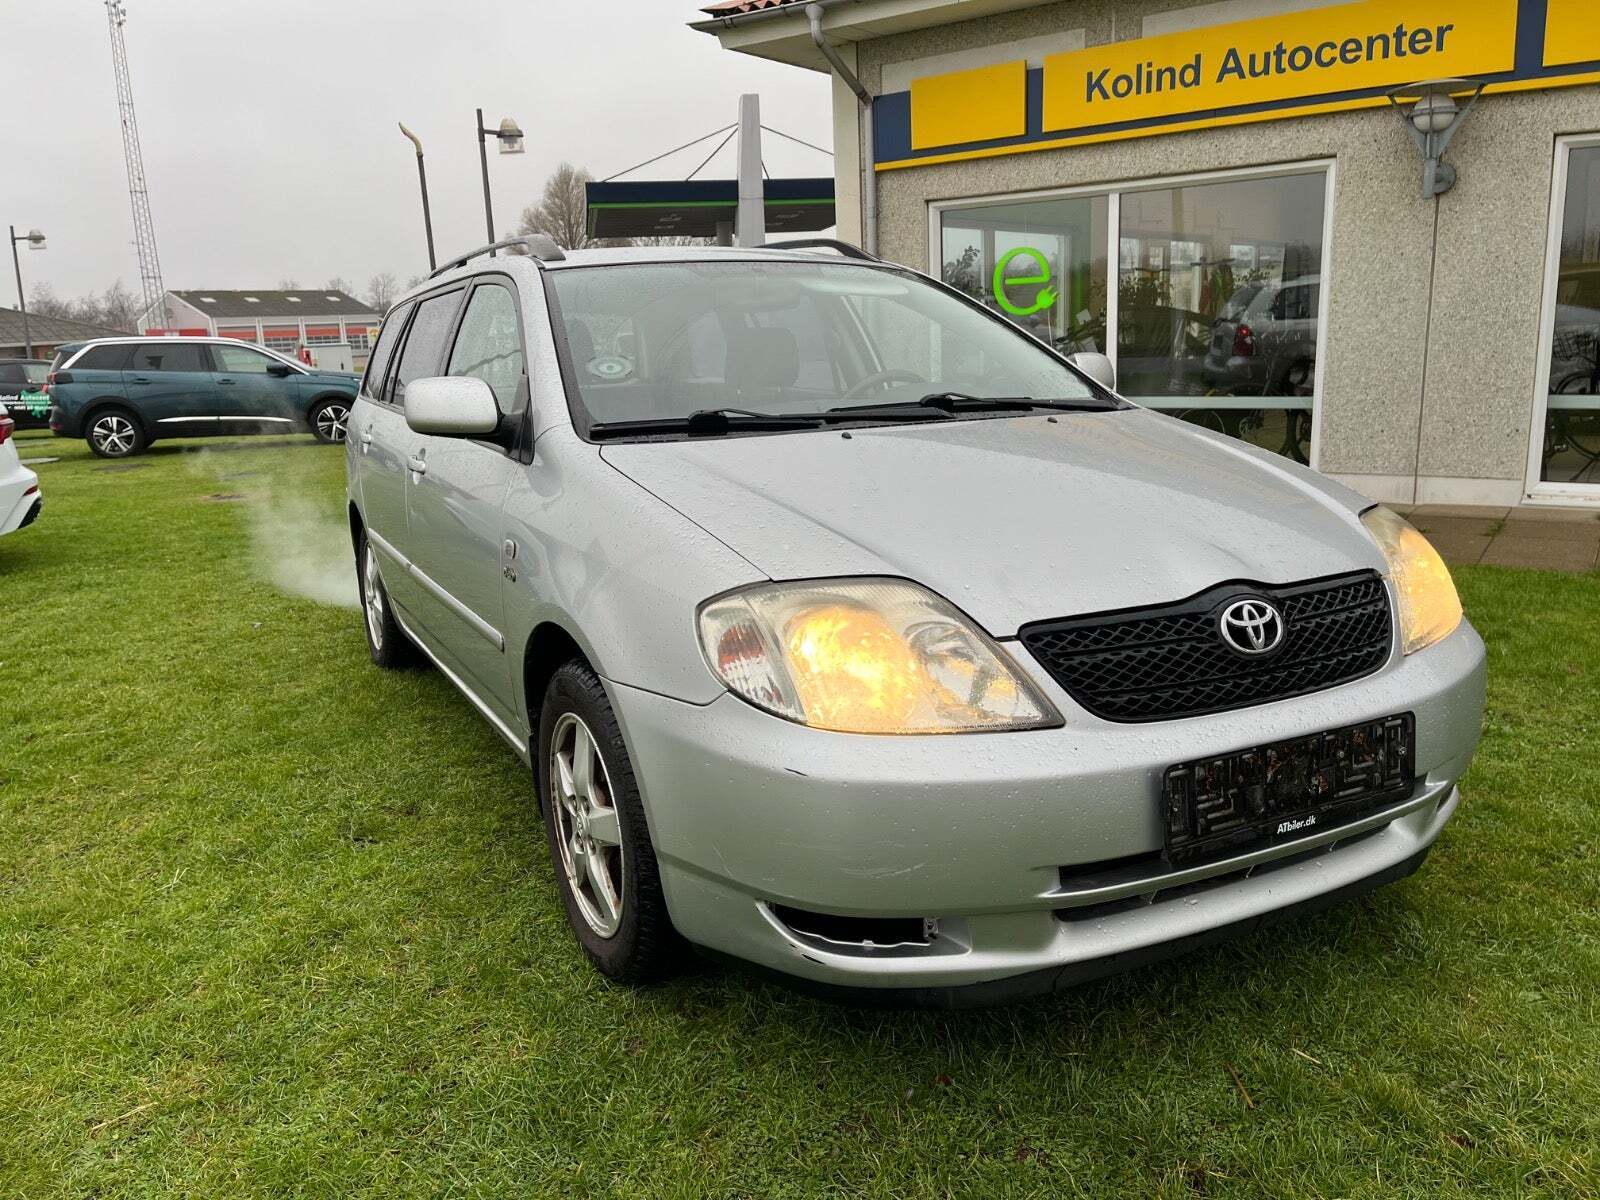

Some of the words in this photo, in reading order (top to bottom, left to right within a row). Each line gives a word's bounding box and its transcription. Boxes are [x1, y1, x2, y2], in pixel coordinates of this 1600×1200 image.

[1085, 53, 1202, 102] Kolind
[1216, 22, 1453, 84] Autocenter
[1276, 815, 1317, 835] ATbiler.dk
